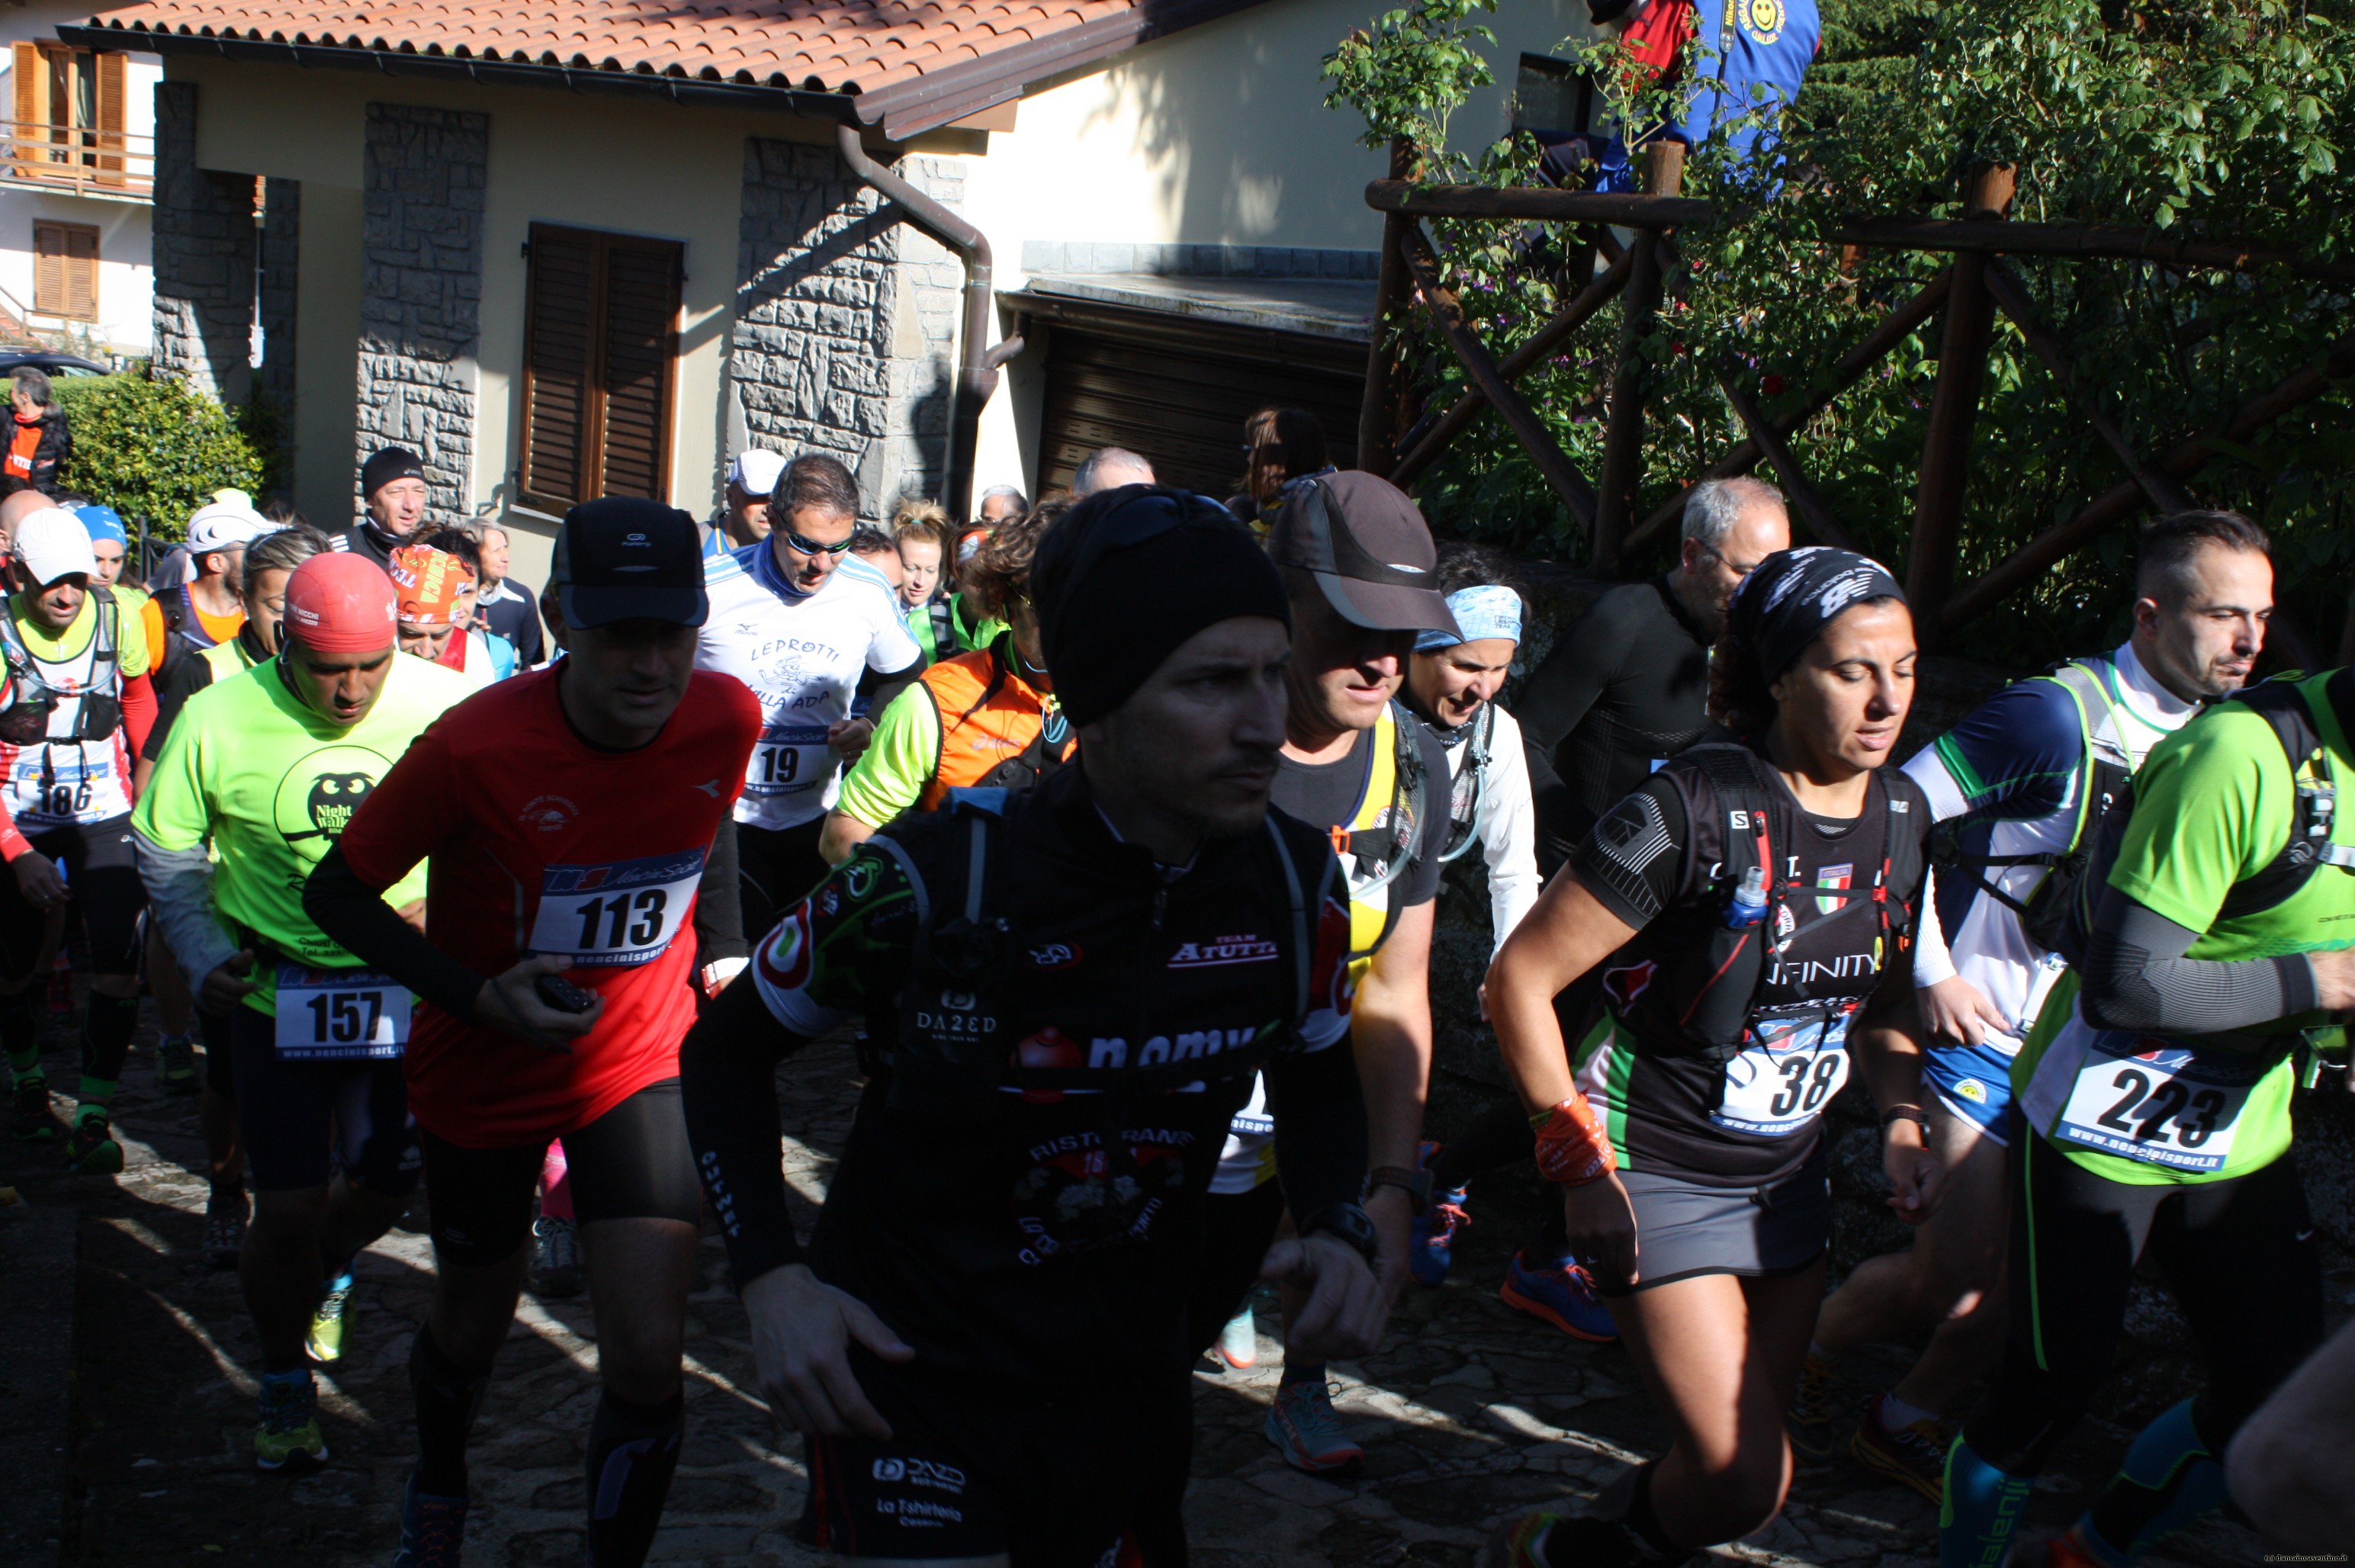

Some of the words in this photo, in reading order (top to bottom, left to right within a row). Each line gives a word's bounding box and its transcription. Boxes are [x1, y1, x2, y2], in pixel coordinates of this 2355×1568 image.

[750, 638, 840, 663] LEPROTTI
[781, 686, 796, 695] di
[792, 690, 830, 710] ADA
[760, 747, 799, 783] 19
[37, 782, 93, 816] 186
[316, 804, 353, 818] Night
[577, 888, 667, 949] 113
[1215, 933, 1258, 943] TEAM
[307, 991, 383, 1043] 157
[1770, 1053, 1840, 1117] 38
[2096, 1068, 2226, 1149] 223
[1967, 1477, 2031, 1568] alenji
